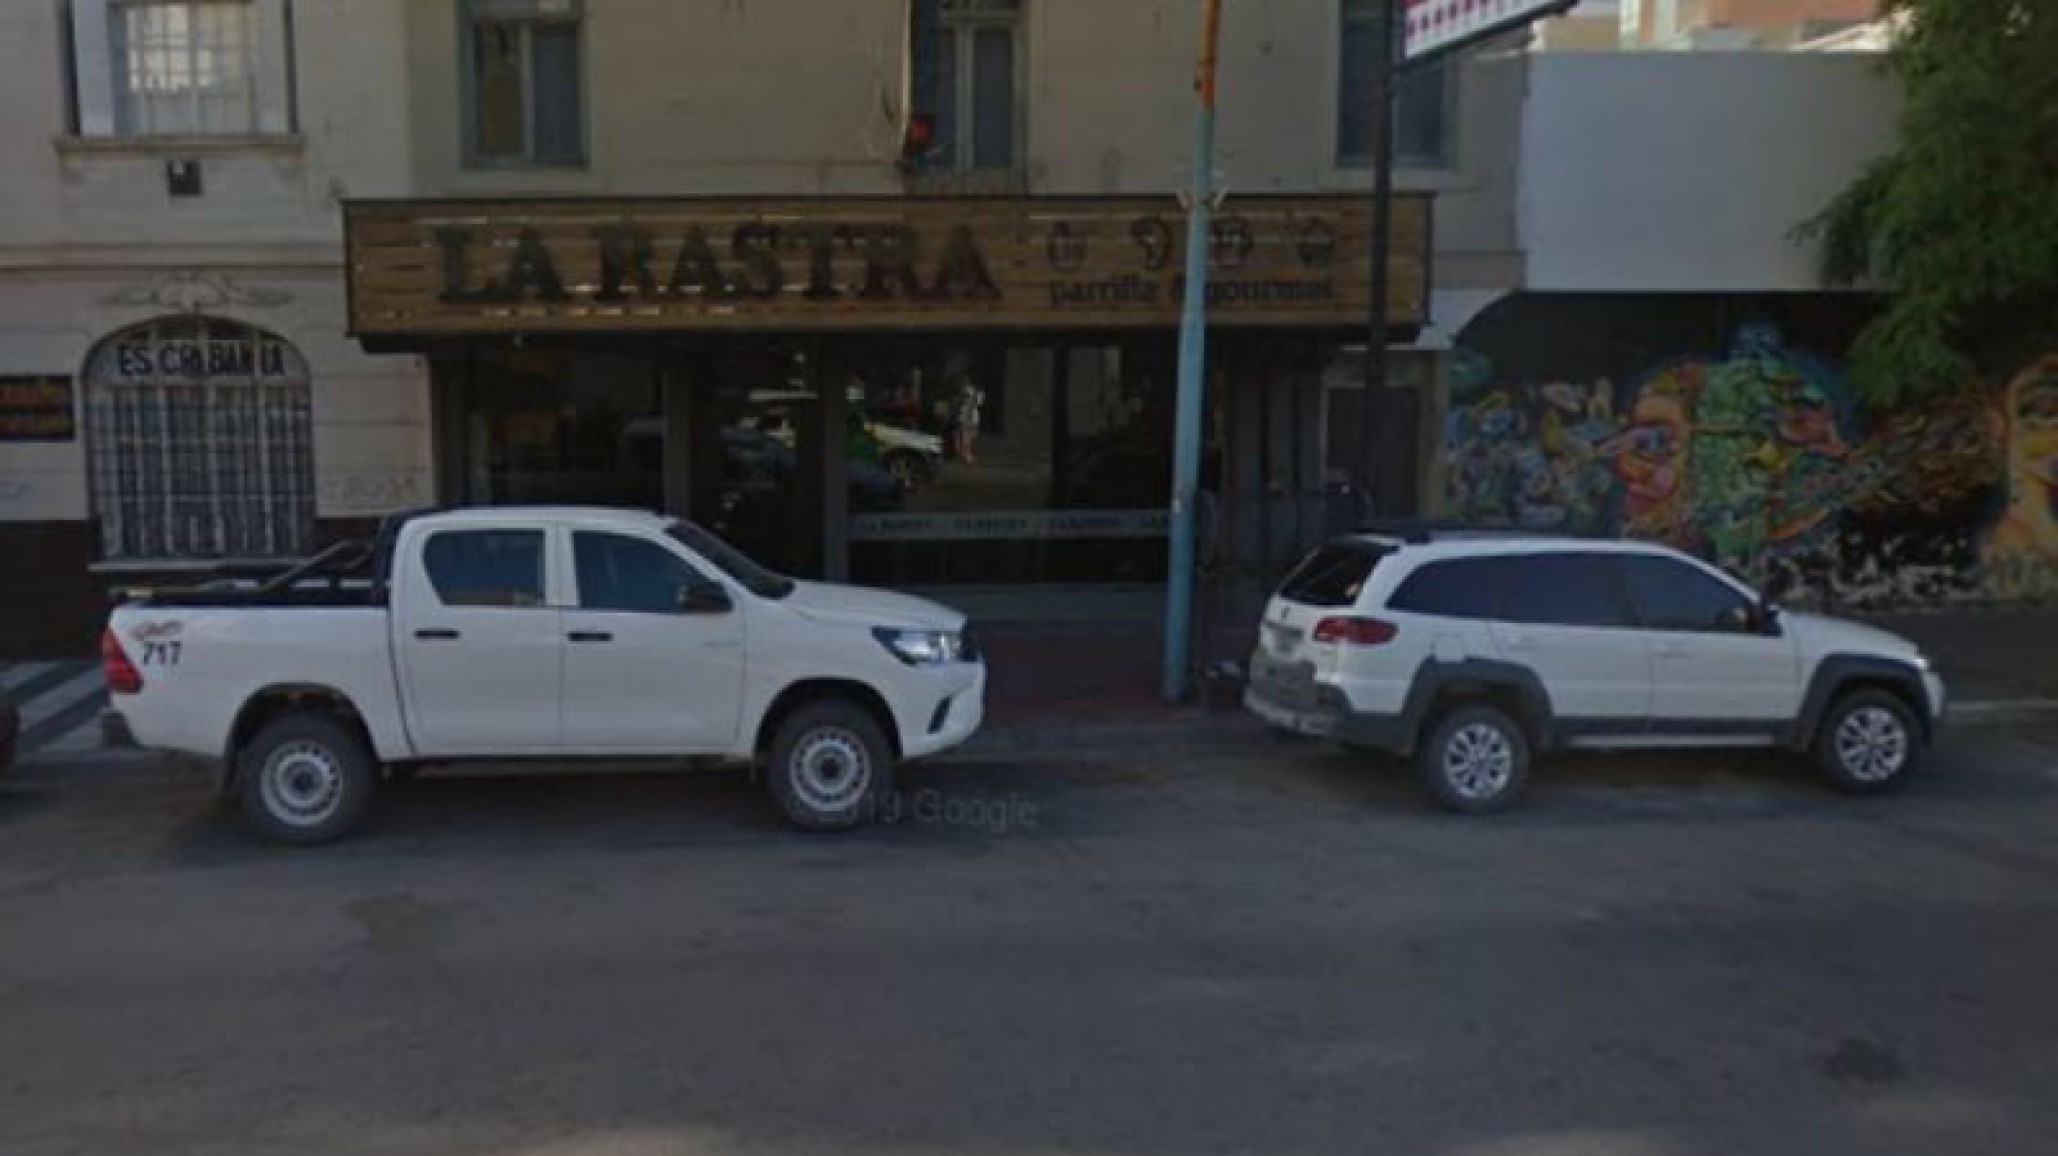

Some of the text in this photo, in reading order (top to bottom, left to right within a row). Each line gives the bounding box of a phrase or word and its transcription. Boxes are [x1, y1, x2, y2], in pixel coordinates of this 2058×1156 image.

[435, 223, 1002, 304] LA RASTRA
[142, 641, 182, 664] 717
